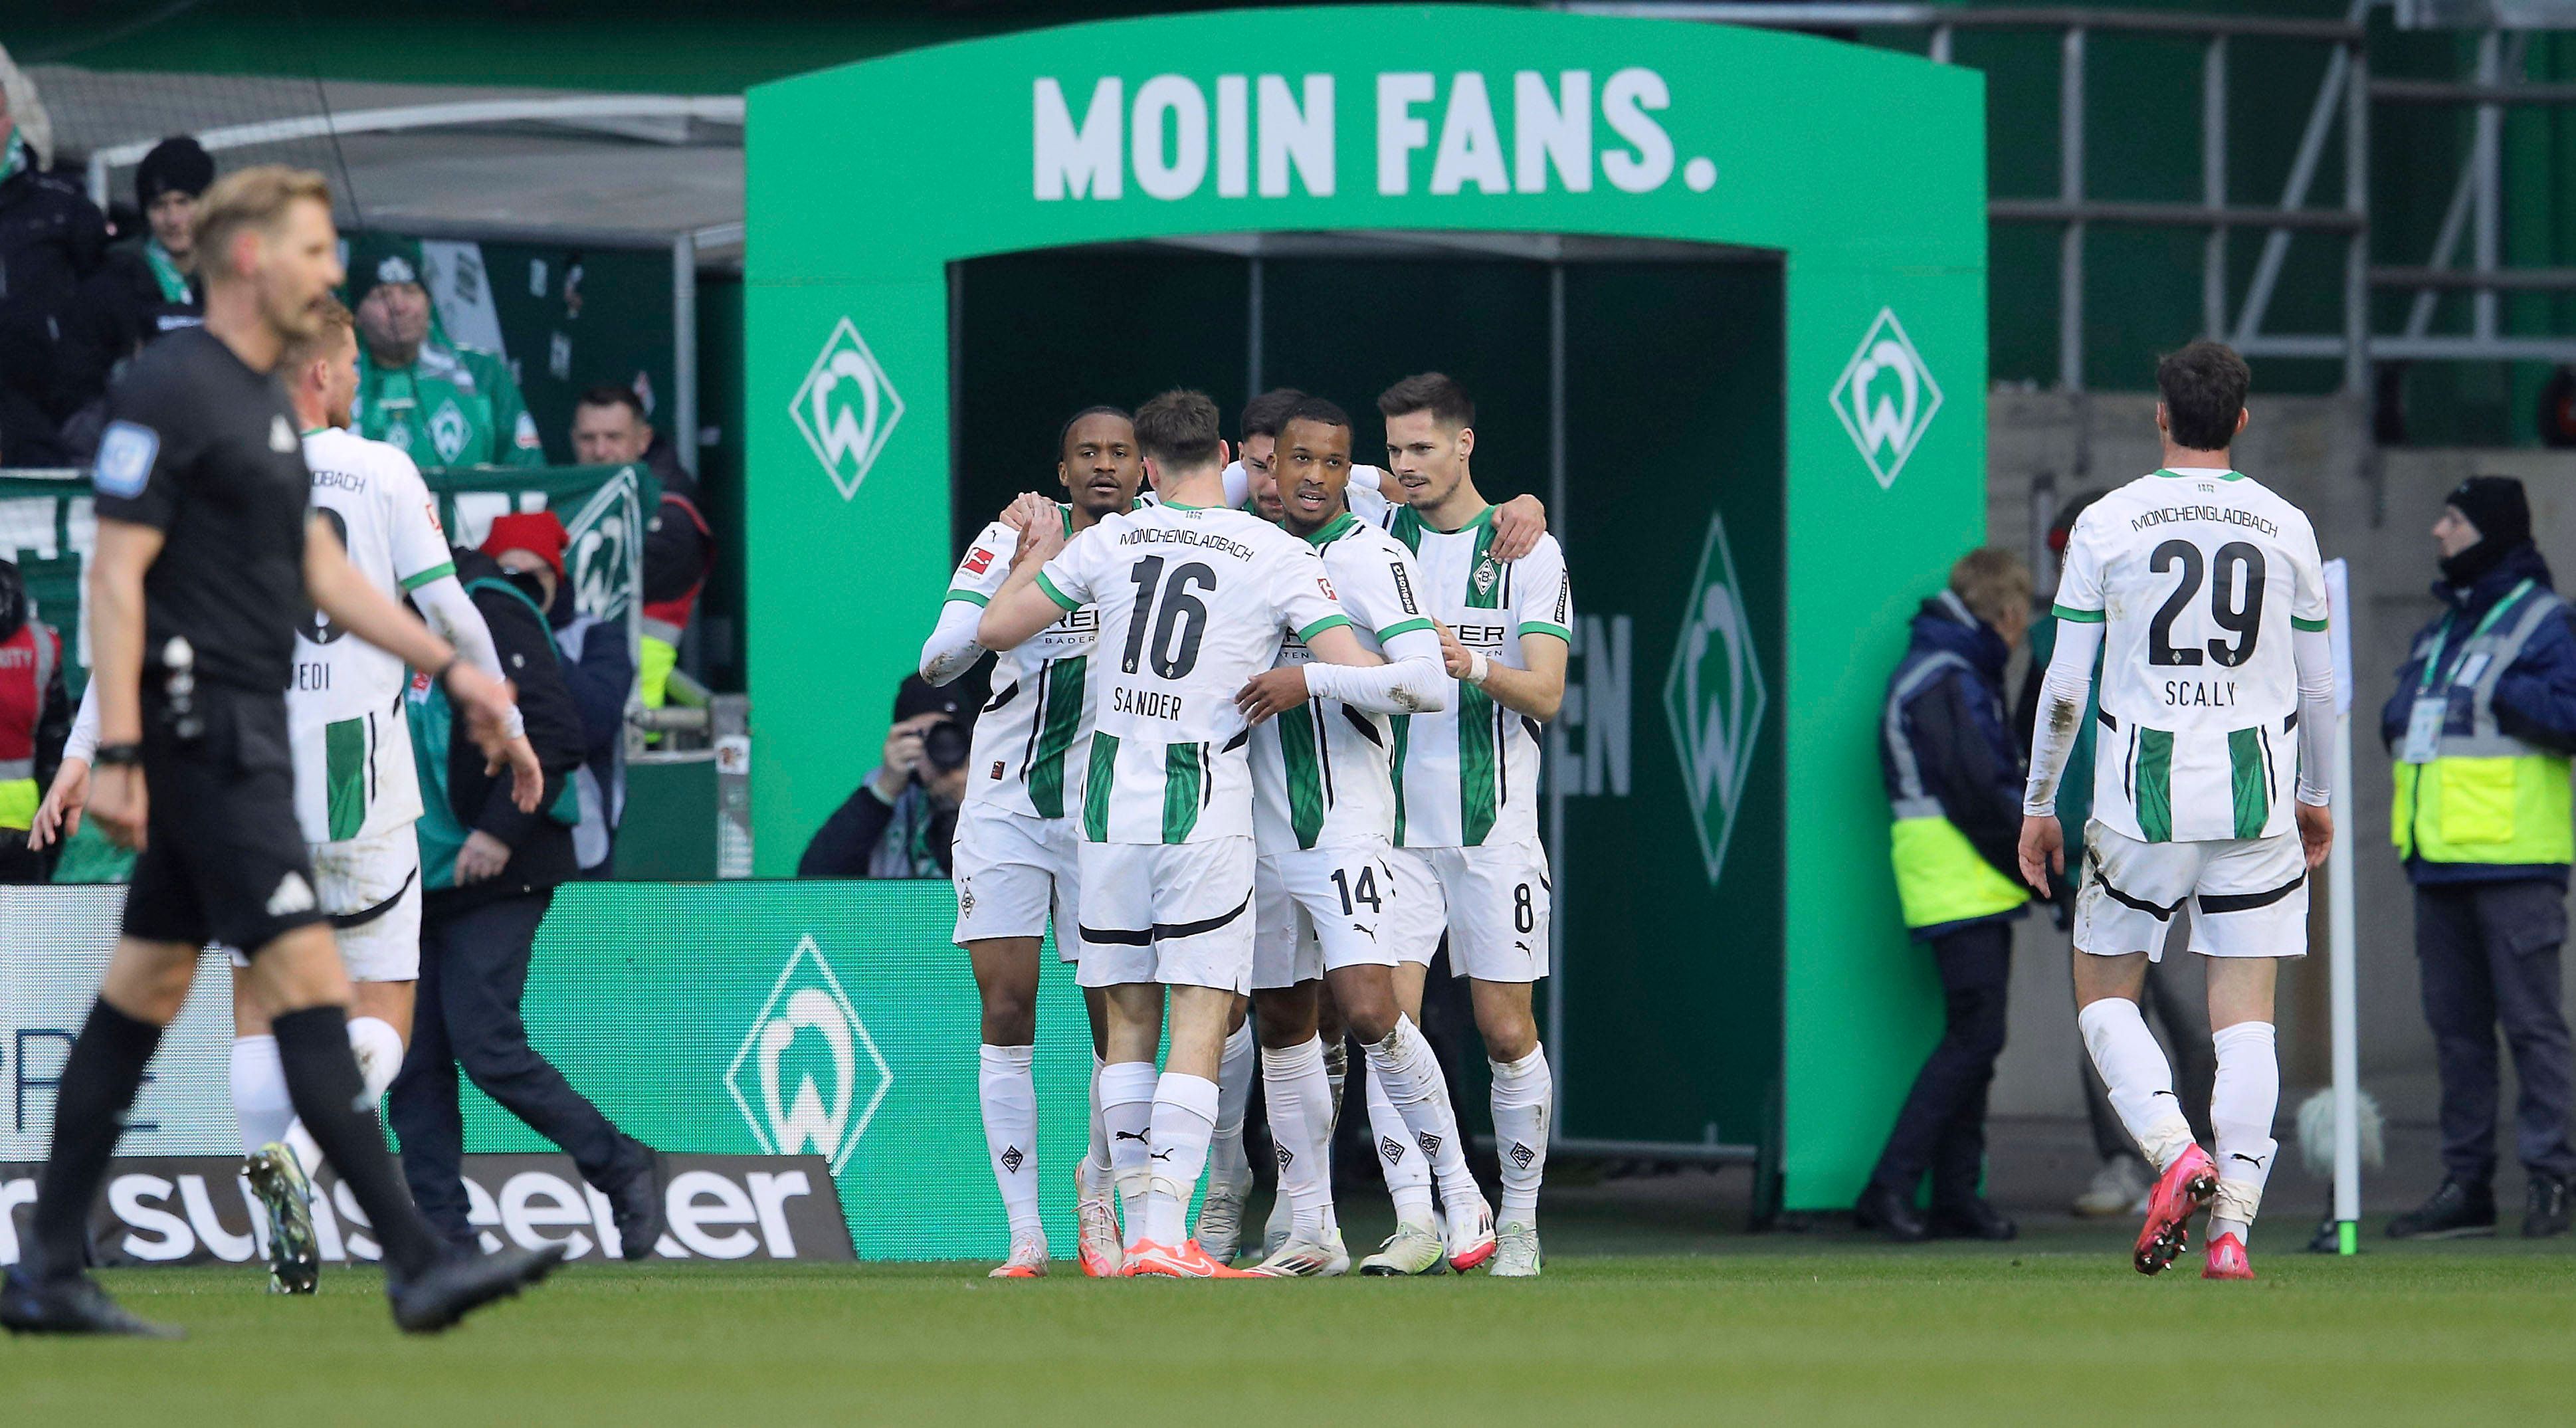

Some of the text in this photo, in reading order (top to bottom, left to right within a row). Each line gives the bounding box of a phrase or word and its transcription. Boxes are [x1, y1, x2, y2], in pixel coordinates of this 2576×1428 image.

[1033, 68, 1718, 201] MOIN FANS.
[2131, 506, 2278, 538] MÖNCHENGLADBACH
[1120, 528, 1254, 562] MÖNCHENGLADBACH
[1397, 575, 1416, 614] sonepar
[2149, 540, 2266, 667] 29
[1122, 555, 1217, 680] 16
[1114, 686, 1182, 722] SANDER
[2165, 680, 2235, 707] SCALY
[1330, 866, 1382, 916] 14
[1514, 882, 1534, 934] 8
